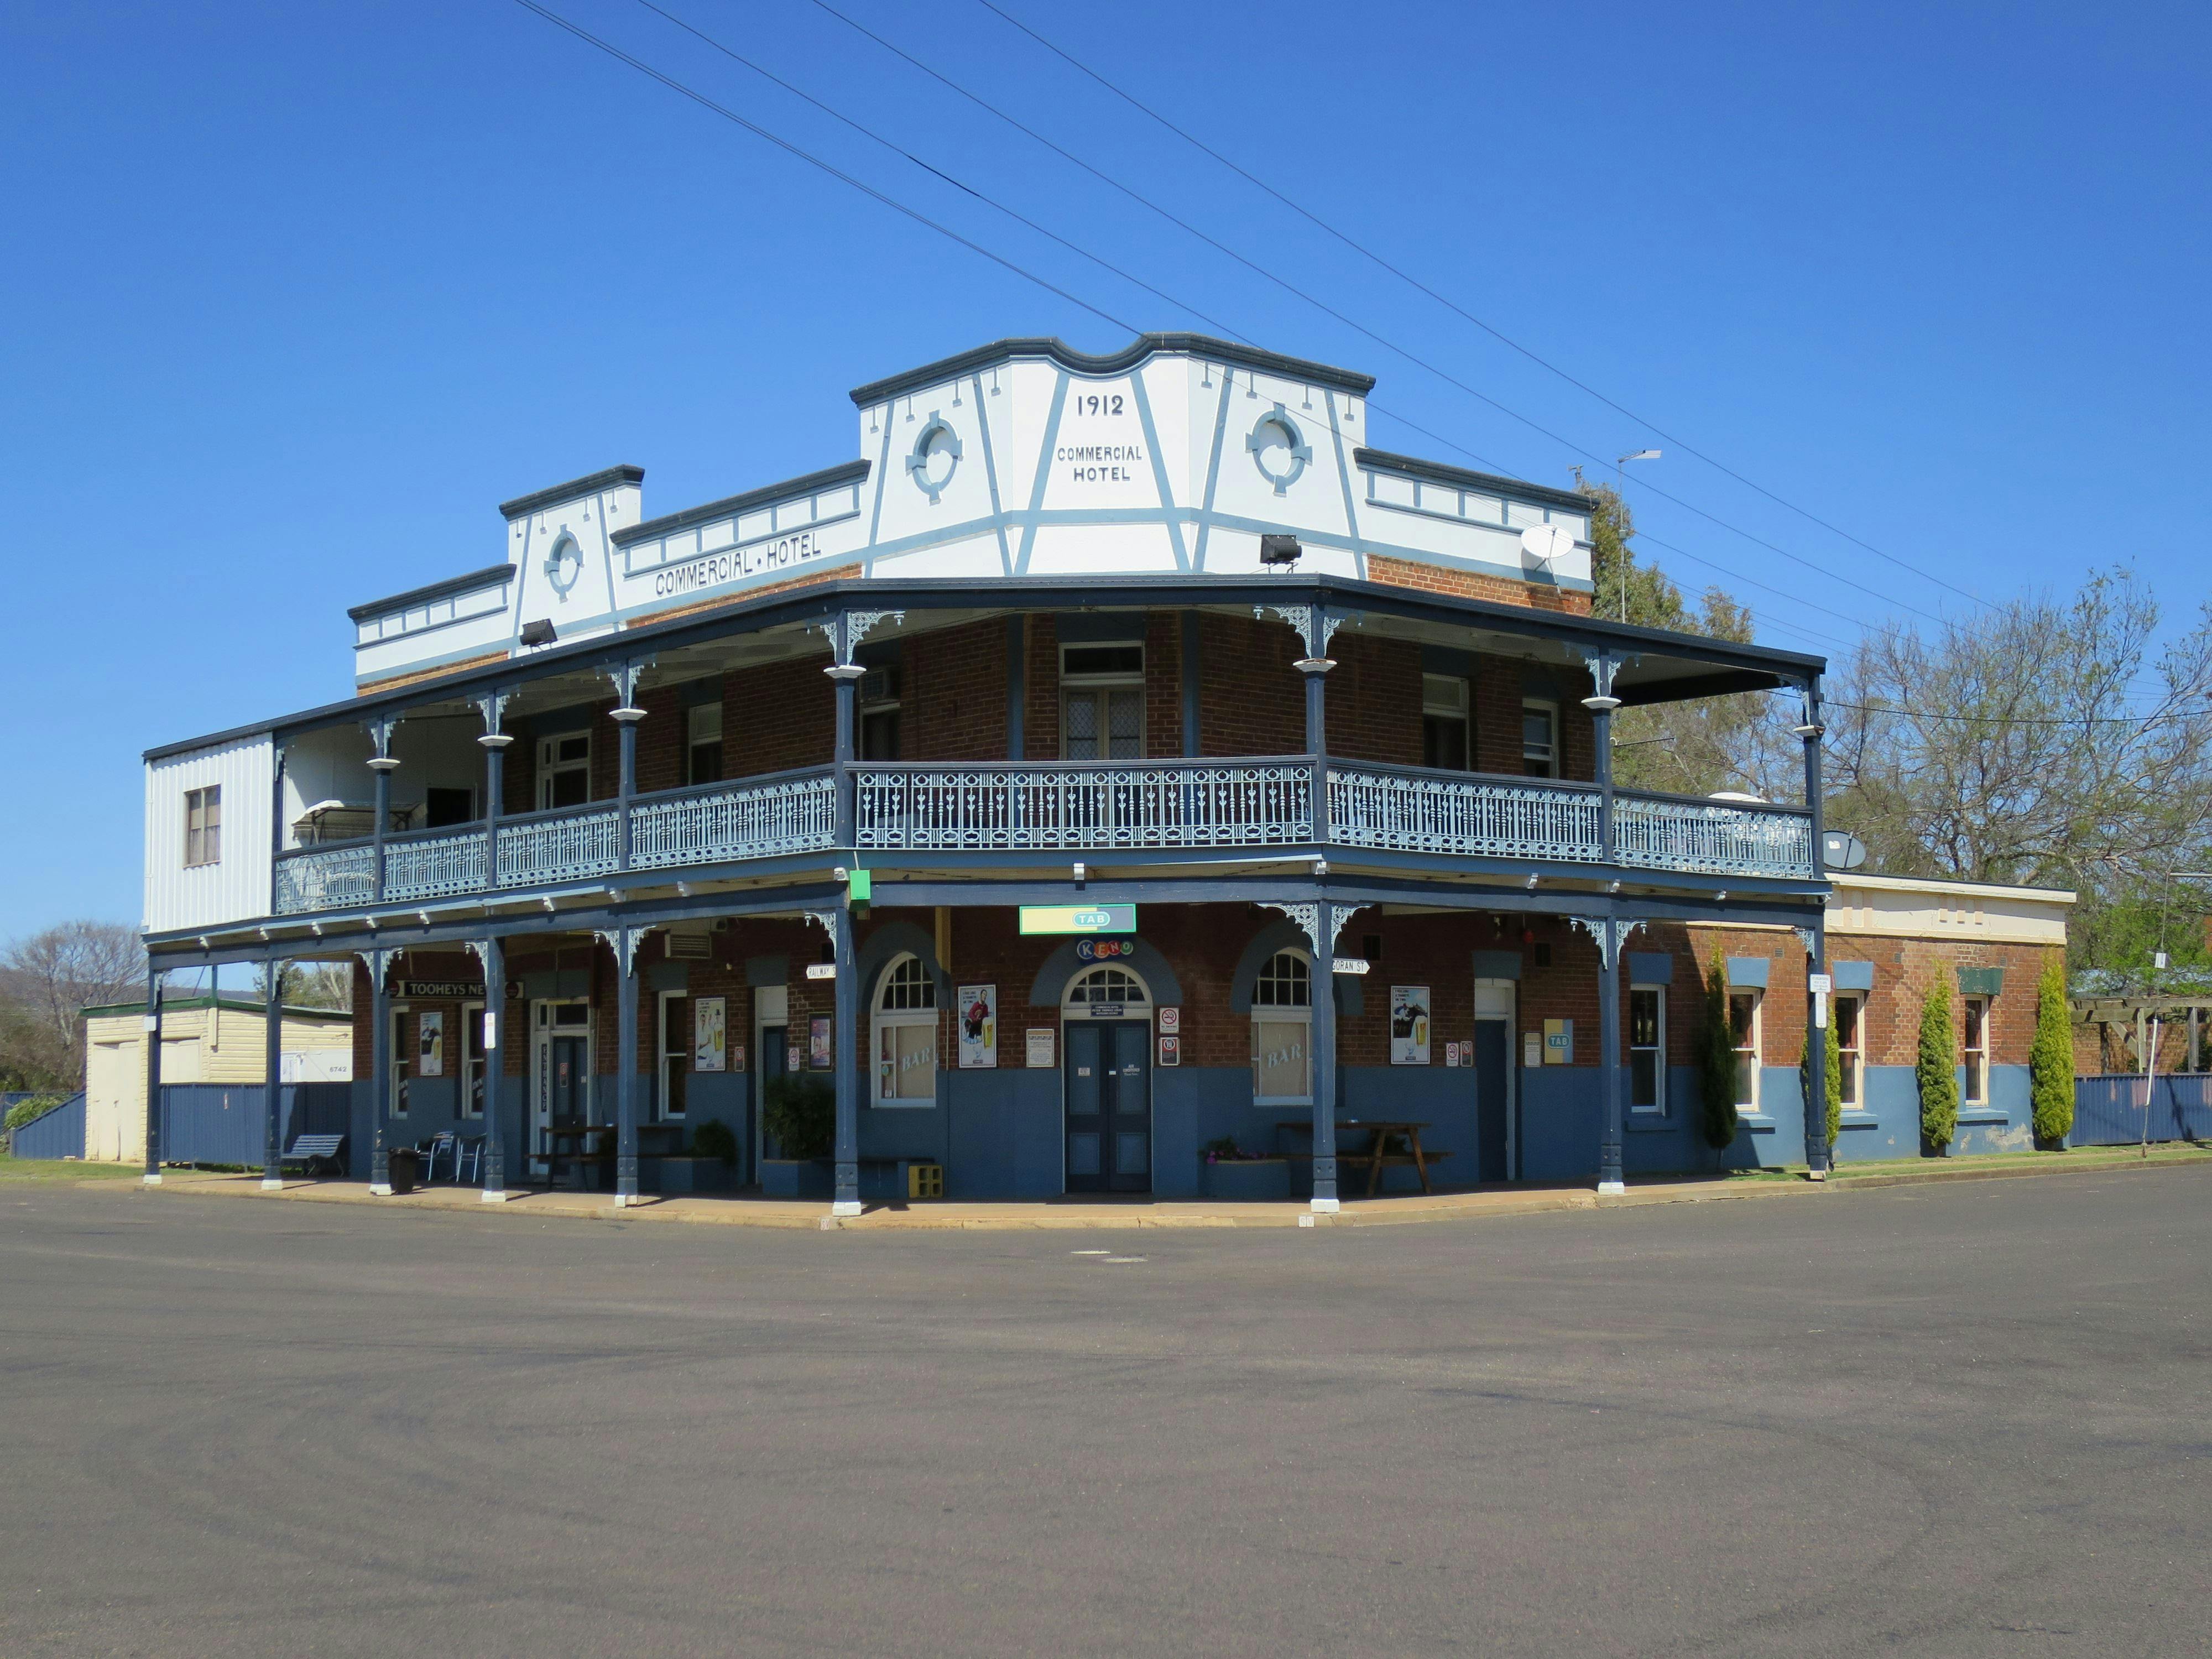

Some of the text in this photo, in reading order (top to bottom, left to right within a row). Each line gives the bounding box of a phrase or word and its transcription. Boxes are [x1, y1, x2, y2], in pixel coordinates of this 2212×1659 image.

[1077, 395, 1124, 416] 1912
[1057, 446, 1142, 462] COMMERCIAL
[1073, 467, 1130, 482] HOTEL
[655, 533, 822, 597] COMMERCIAL HOTEL
[1079, 915, 1105, 924] TAB
[1081, 941, 1131, 957] KENO
[808, 967, 830, 977] RAILWAY
[1357, 962, 1364, 972] ST
[409, 984, 466, 995] TOOHEYS
[469, 984, 486, 995] NE
[1550, 1037, 1567, 1046] TAB
[902, 1047, 930, 1072] BAR
[1267, 1043, 1301, 1069] BAR
